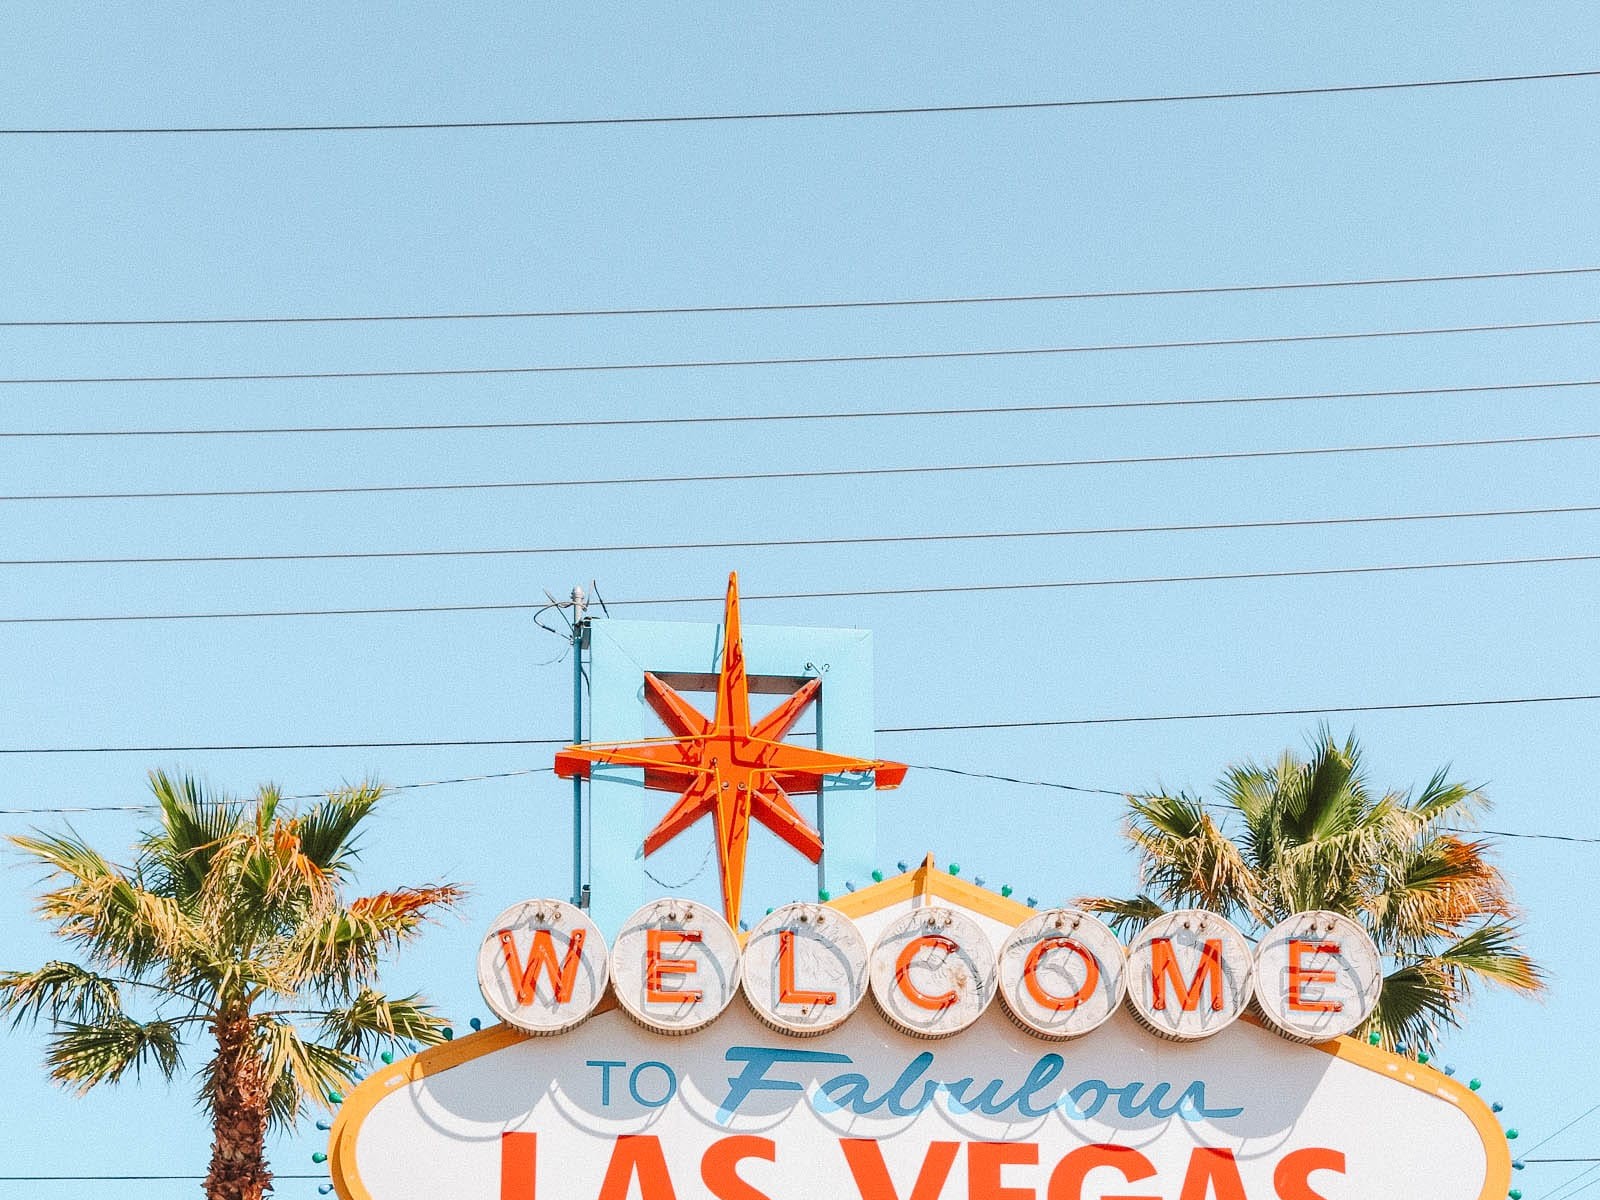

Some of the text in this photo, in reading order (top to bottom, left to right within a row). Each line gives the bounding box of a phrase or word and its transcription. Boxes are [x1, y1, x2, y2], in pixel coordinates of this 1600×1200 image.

[500, 928, 1344, 1013] WELCOME
[586, 1046, 1244, 1124] TO Fabulous
